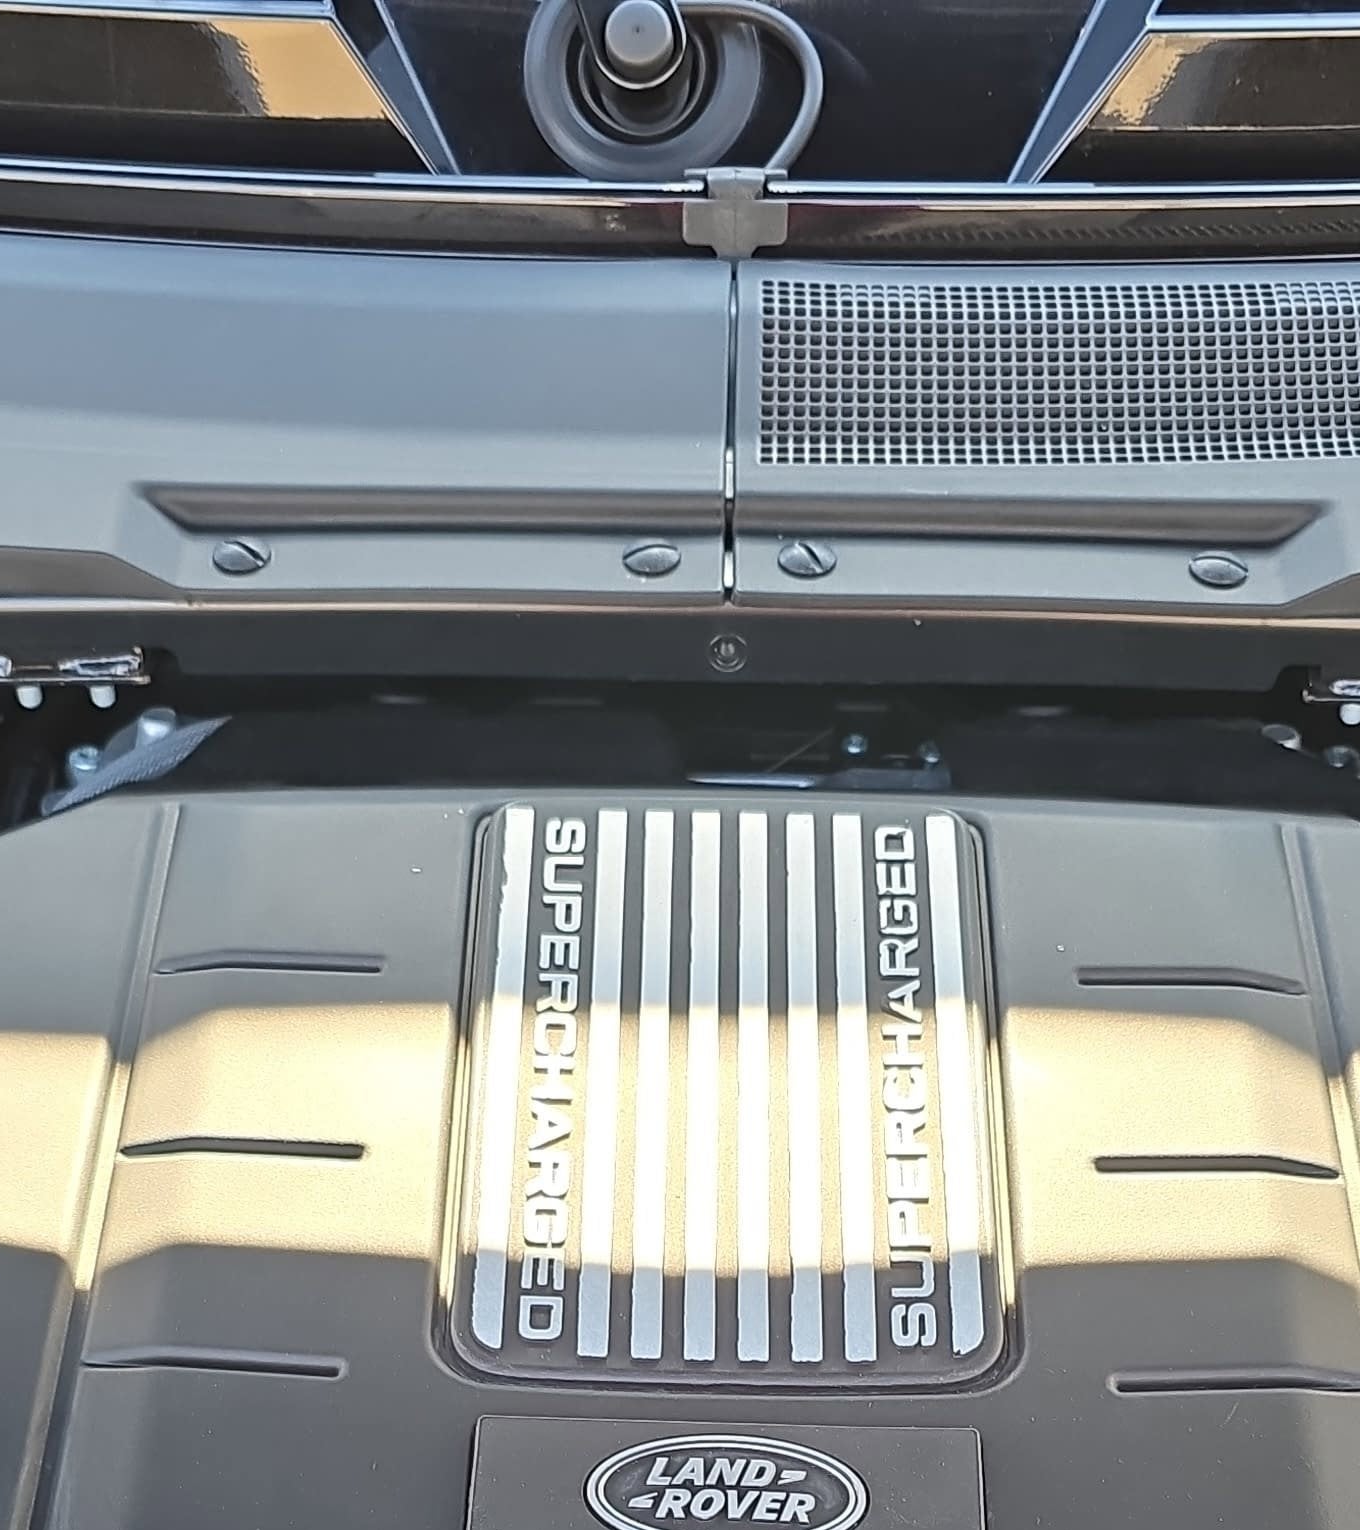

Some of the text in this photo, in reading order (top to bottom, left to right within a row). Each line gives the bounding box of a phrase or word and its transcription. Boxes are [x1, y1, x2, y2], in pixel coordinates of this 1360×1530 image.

[517, 817, 587, 1341] SUPERCHARGED
[873, 824, 938, 1347] SUPERCHARGED
[646, 1457, 777, 1487] LAND
[655, 1489, 816, 1525] ROVER
